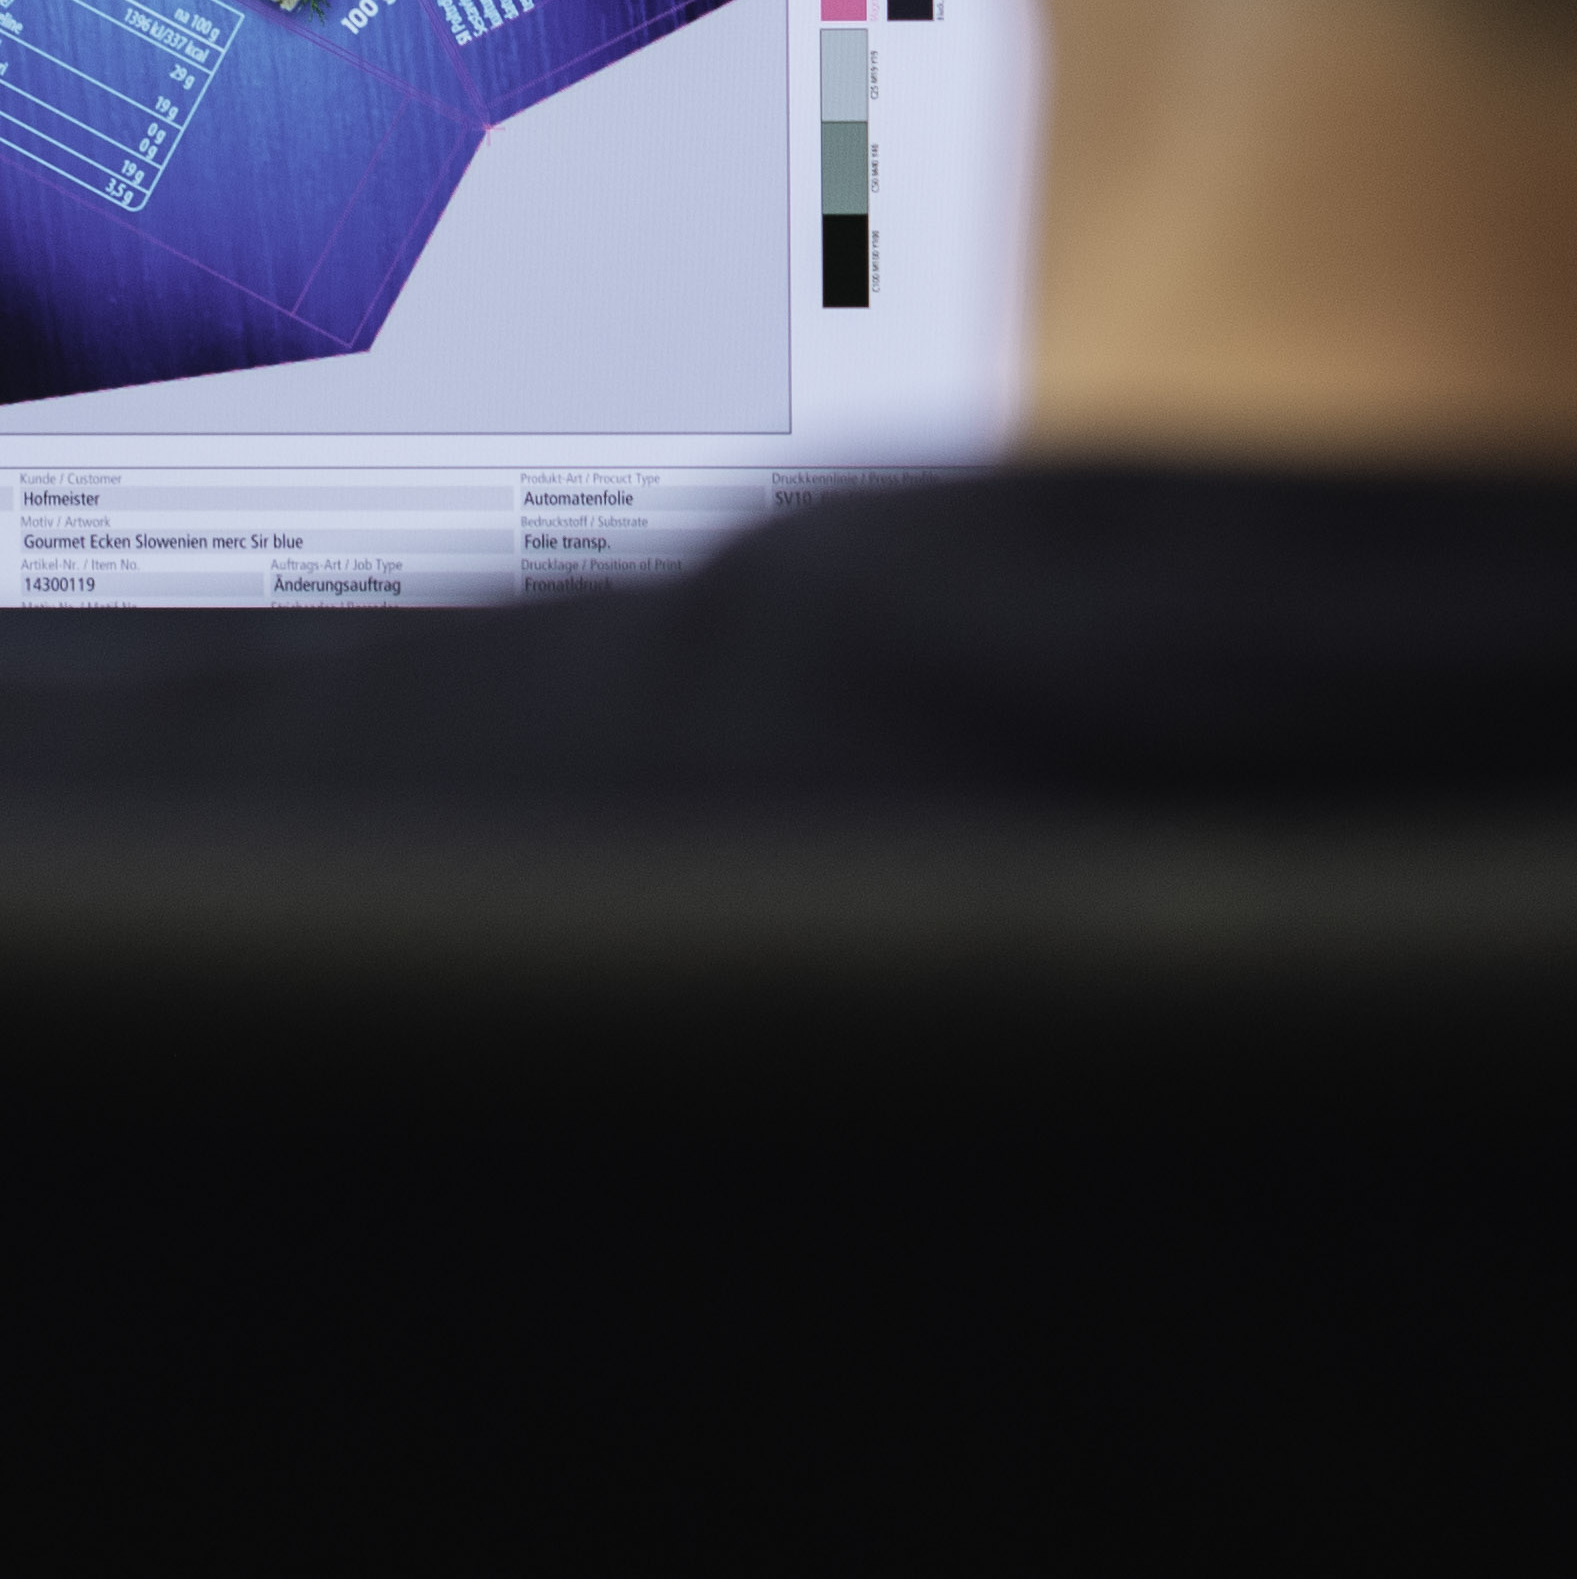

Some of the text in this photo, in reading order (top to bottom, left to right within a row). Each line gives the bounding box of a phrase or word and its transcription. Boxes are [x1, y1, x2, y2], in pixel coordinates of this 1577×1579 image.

[339, 0, 380, 37] 100
[18, 472, 56, 484] Kunde
[67, 472, 121, 484] Customer
[520, 472, 582, 484] Produkt-Art
[635, 472, 660, 487] Type
[22, 490, 98, 505] Hofmeister
[524, 490, 633, 505] Automatenfolie
[19, 515, 54, 527] Motiv
[64, 515, 110, 527] Artwork
[520, 515, 588, 527] Bedruckstoff
[597, 515, 647, 527] Substrate
[23, 533, 303, 548] Gourmet Ecken Slowenien merc Sir blue
[524, 533, 611, 553] Folie transp.
[19, 559, 80, 571] Artikel-Nr.
[90, 559, 116, 571] Item
[119, 559, 138, 571] No.
[270, 558, 341, 573] Auftrags-Art
[351, 557, 372, 572] Job
[376, 558, 402, 573] Type
[520, 558, 578, 573] Drucklage
[589, 558, 636, 570] Position
[638, 558, 650, 570] of
[25, 574, 96, 591] 14300119
[274, 573, 400, 595] Änderungsauftrag
